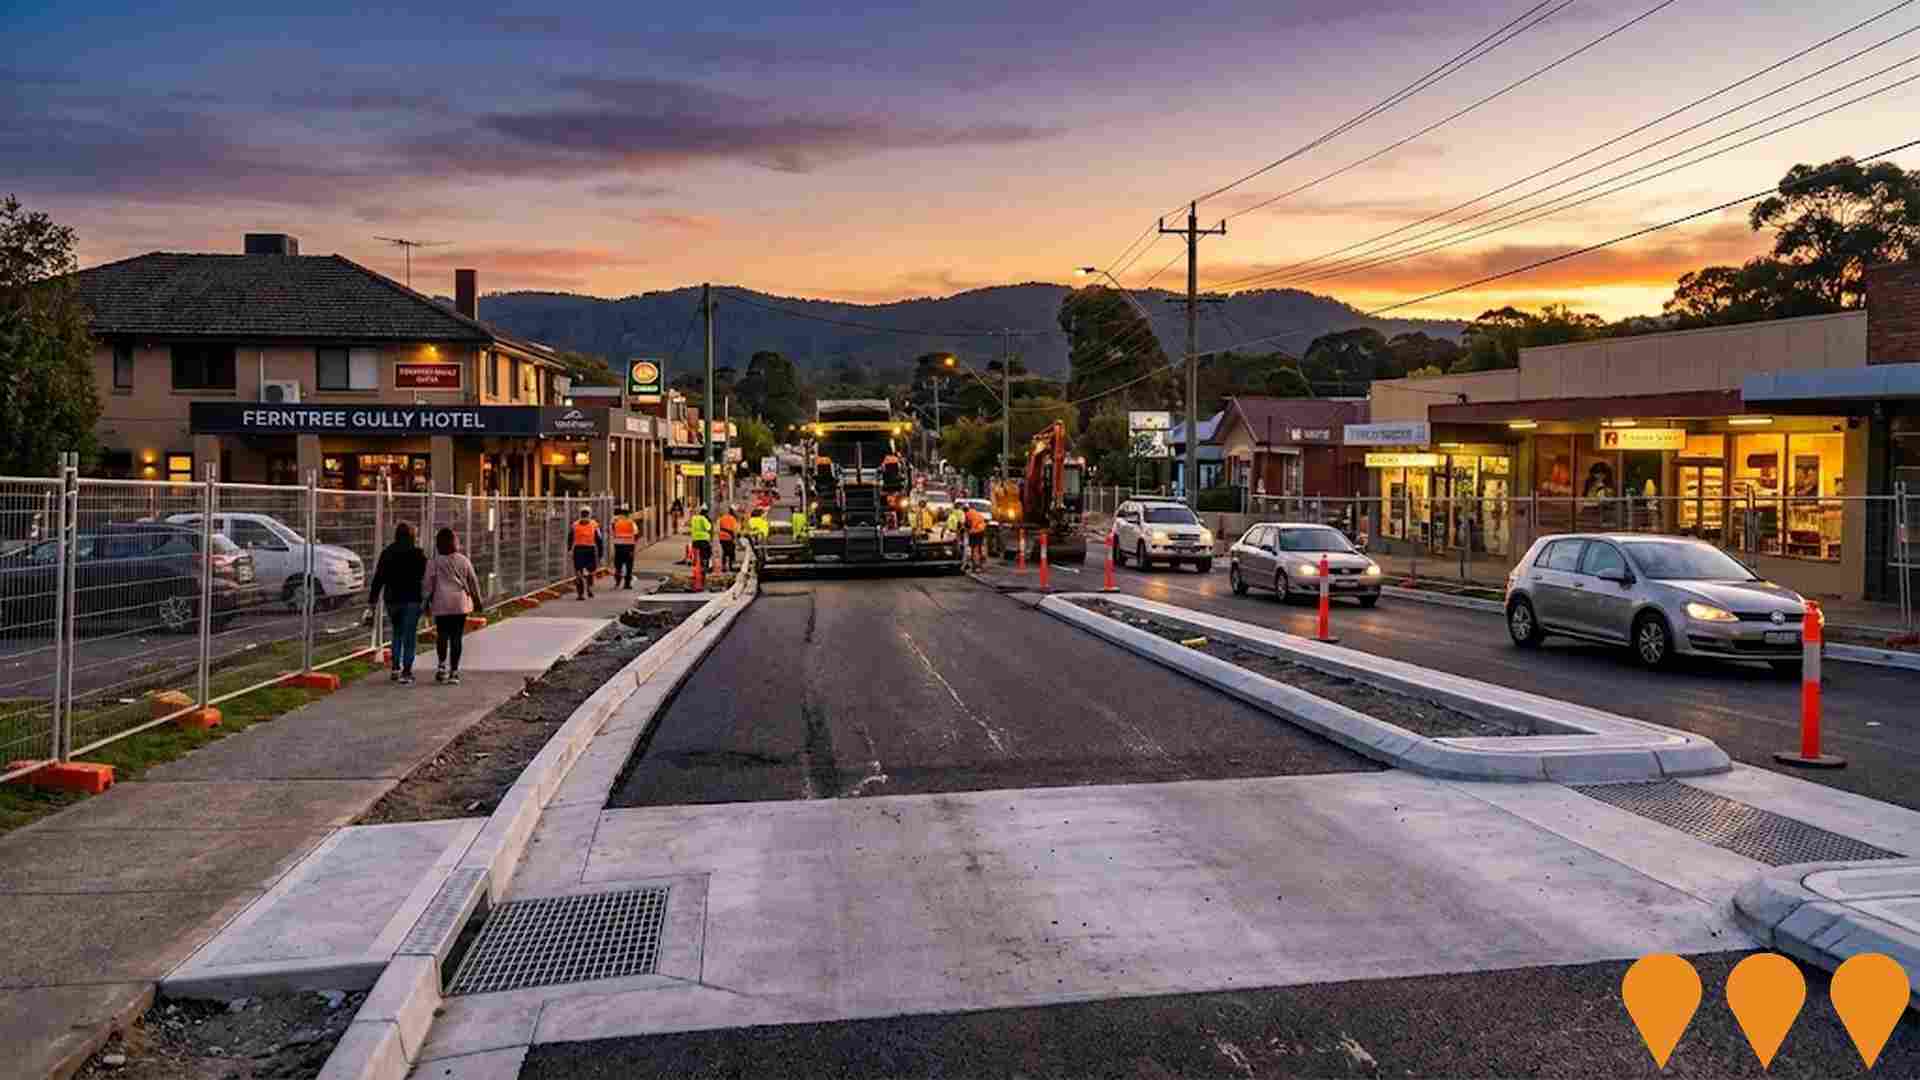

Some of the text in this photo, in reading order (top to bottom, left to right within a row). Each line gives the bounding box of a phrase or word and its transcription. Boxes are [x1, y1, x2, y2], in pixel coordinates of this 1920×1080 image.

[243, 411, 485, 428] FERNTREE GULLY HOTEL
